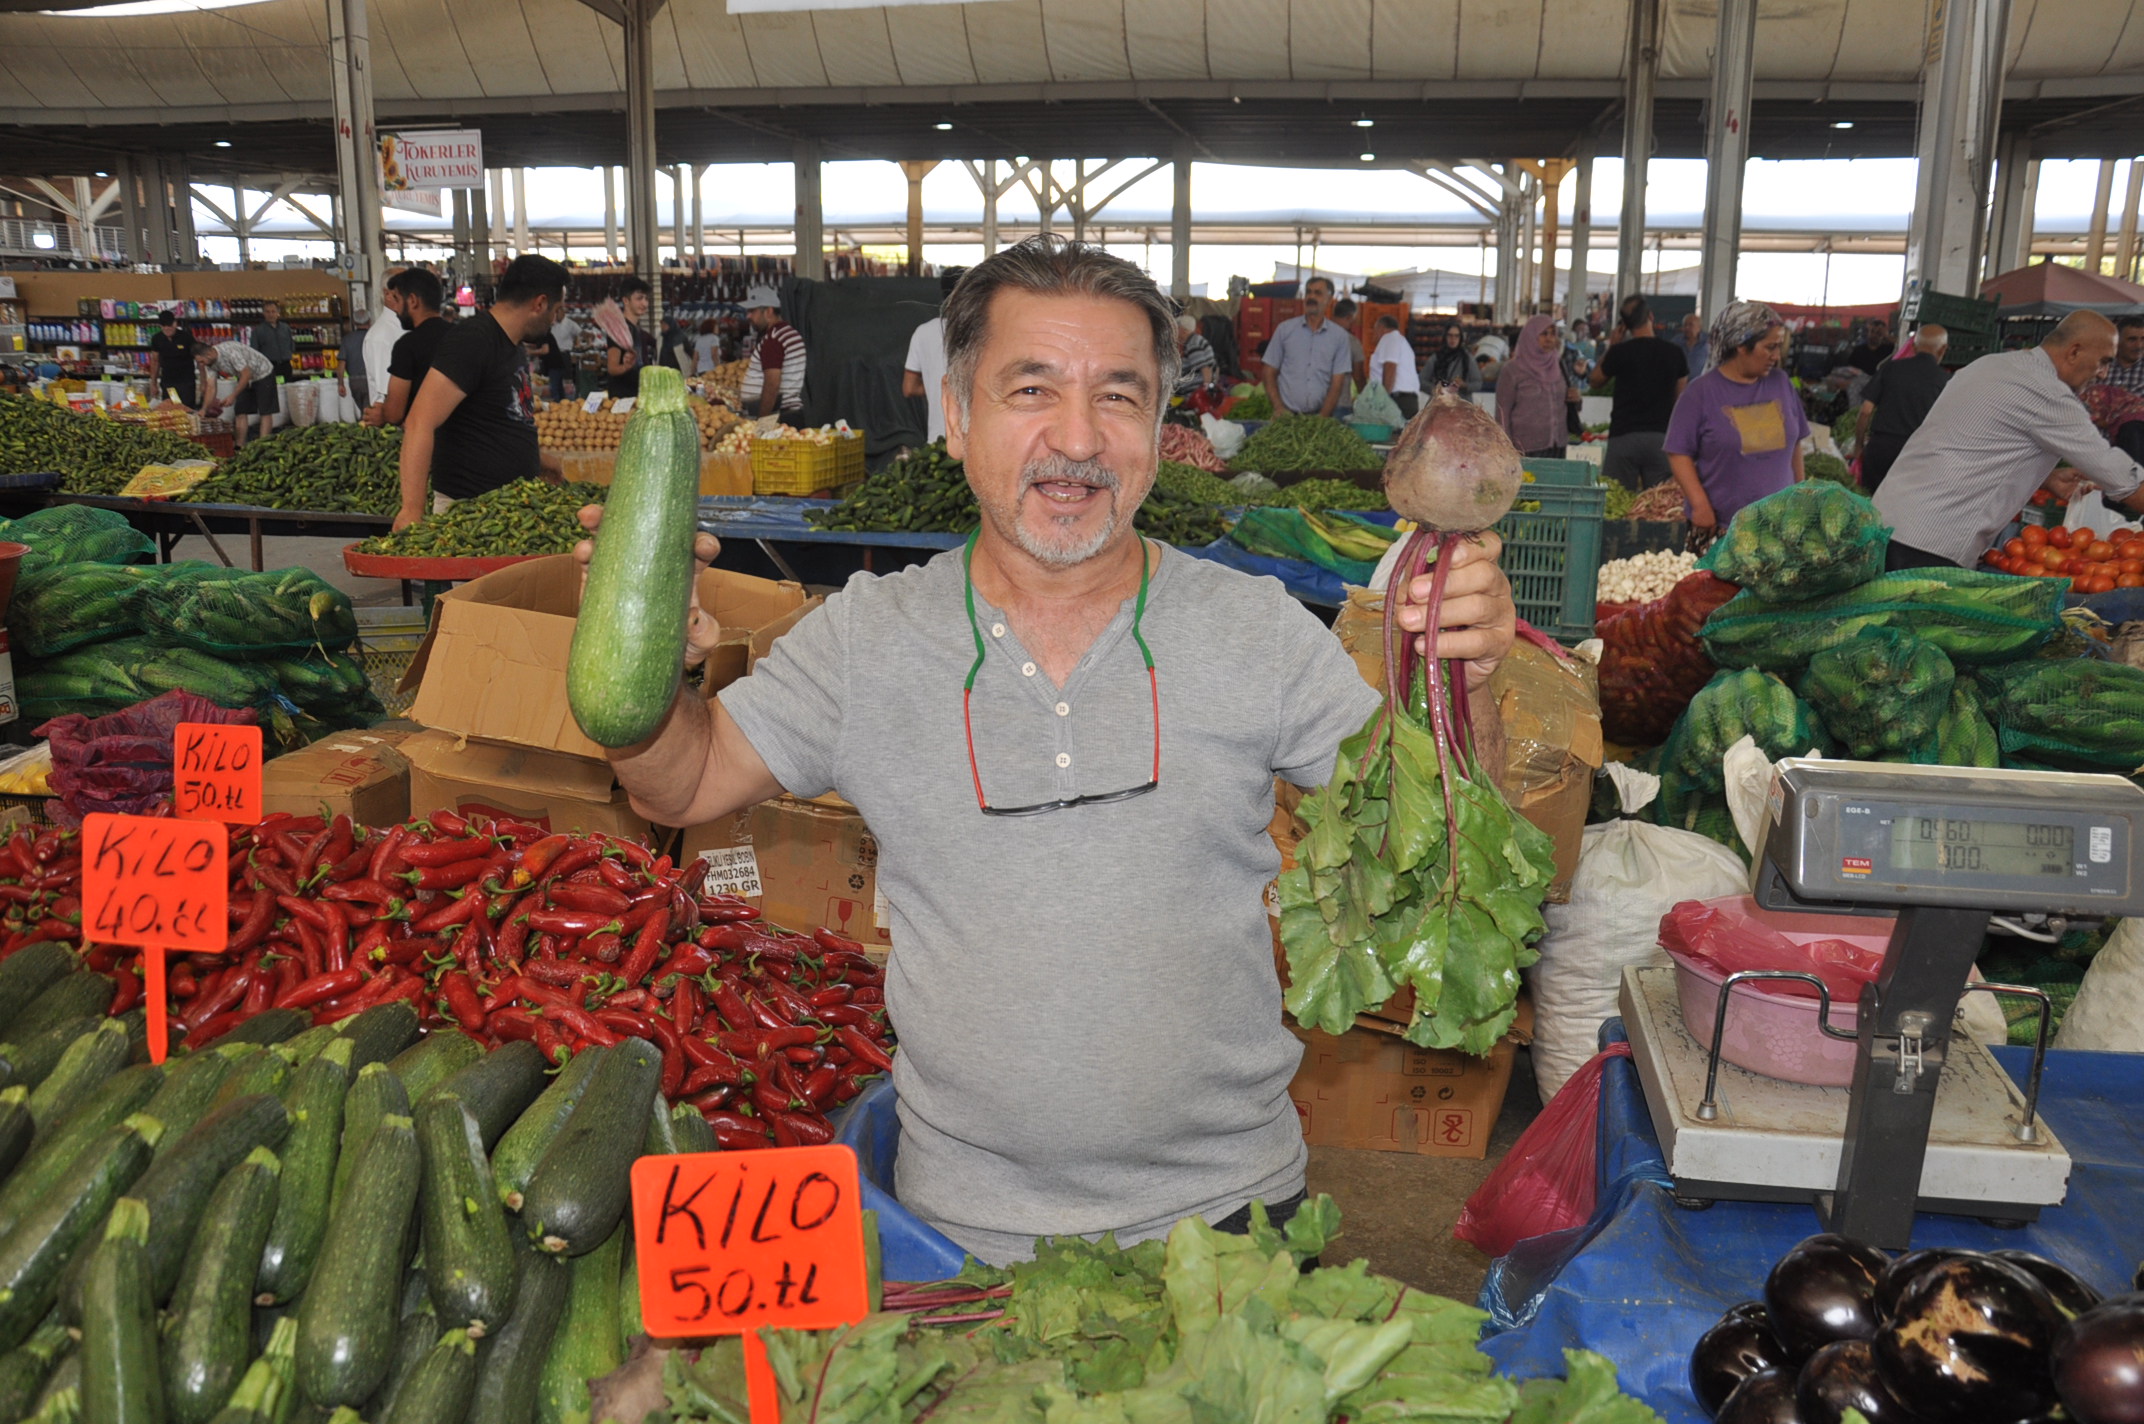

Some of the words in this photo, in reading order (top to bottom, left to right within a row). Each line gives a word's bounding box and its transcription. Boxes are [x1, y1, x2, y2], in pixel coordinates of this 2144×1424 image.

[405, 162, 478, 182] KURUYEMİŞ
[1845, 859, 1870, 867] TEM
[709, 882, 738, 896] 1230
[742, 879, 760, 891] GR
